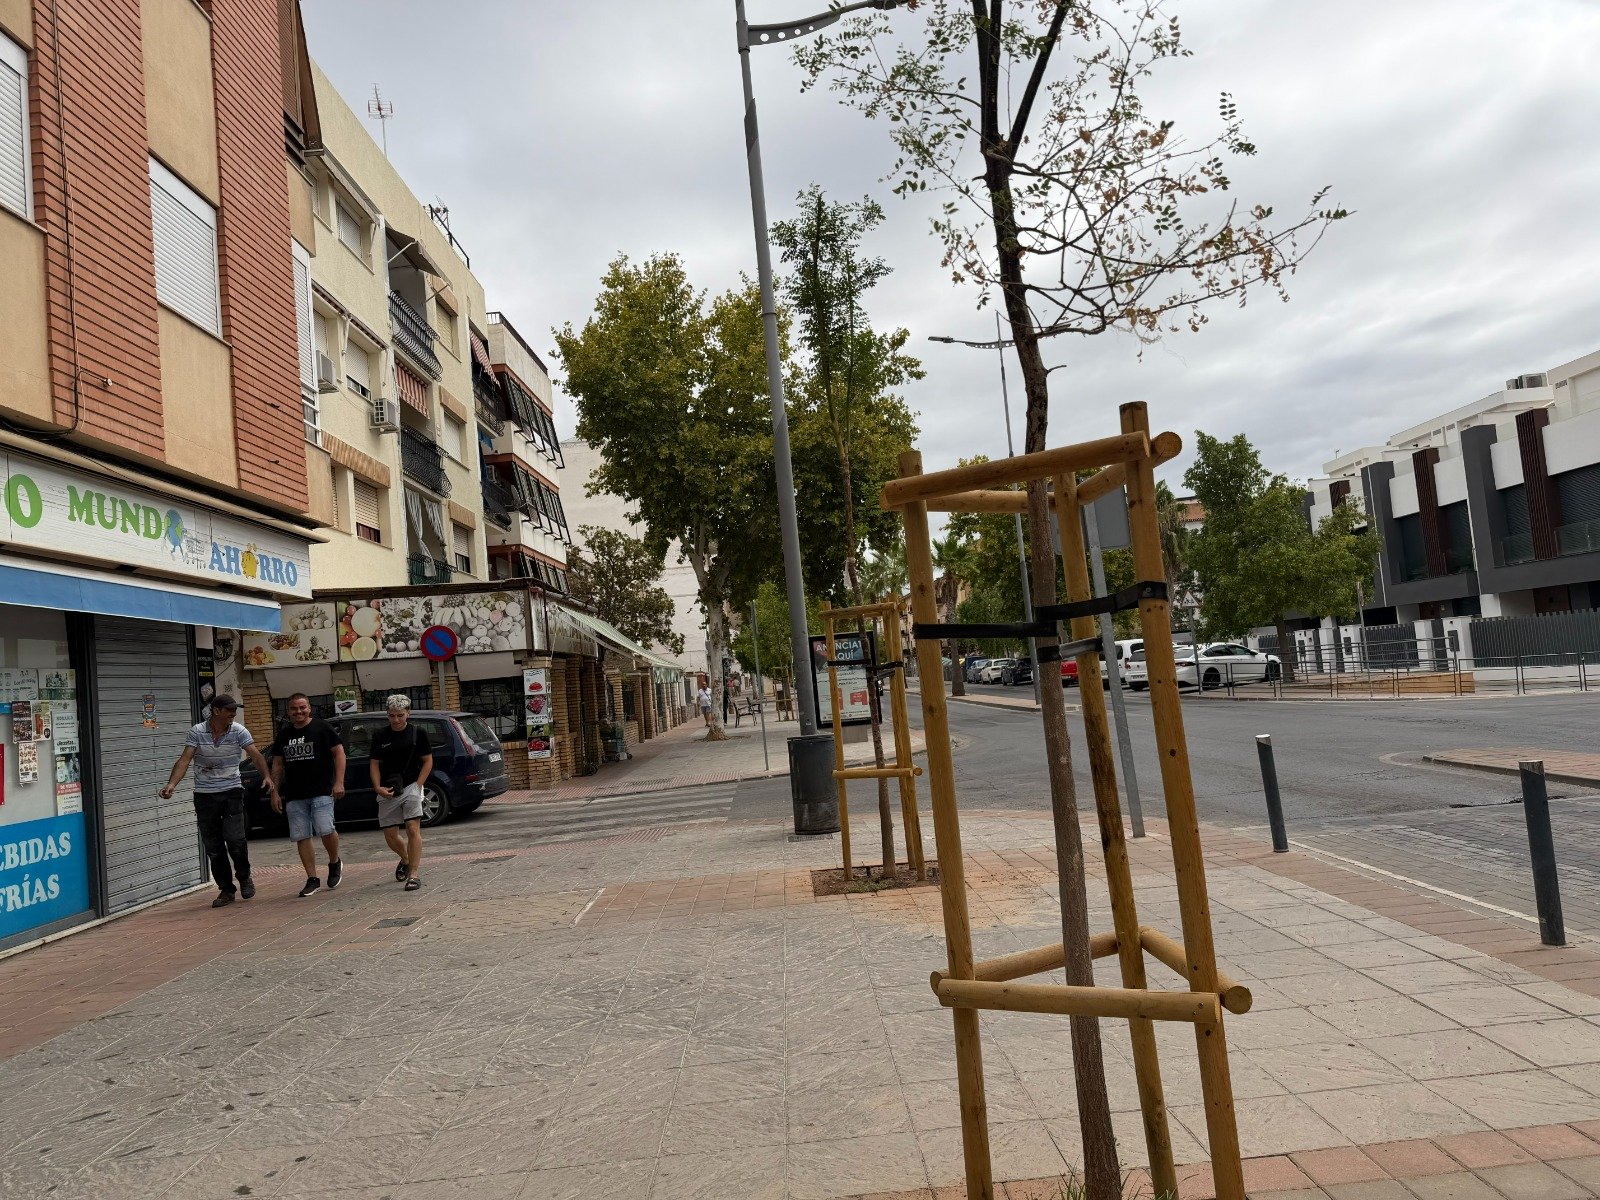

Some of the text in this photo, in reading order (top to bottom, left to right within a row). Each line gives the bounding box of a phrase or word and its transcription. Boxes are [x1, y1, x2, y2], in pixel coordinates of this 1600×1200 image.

[815, 640, 861, 651] ANNCIAT
[297, 735, 305, 744] SÉ
[0, 832, 71, 871] BIDAS
